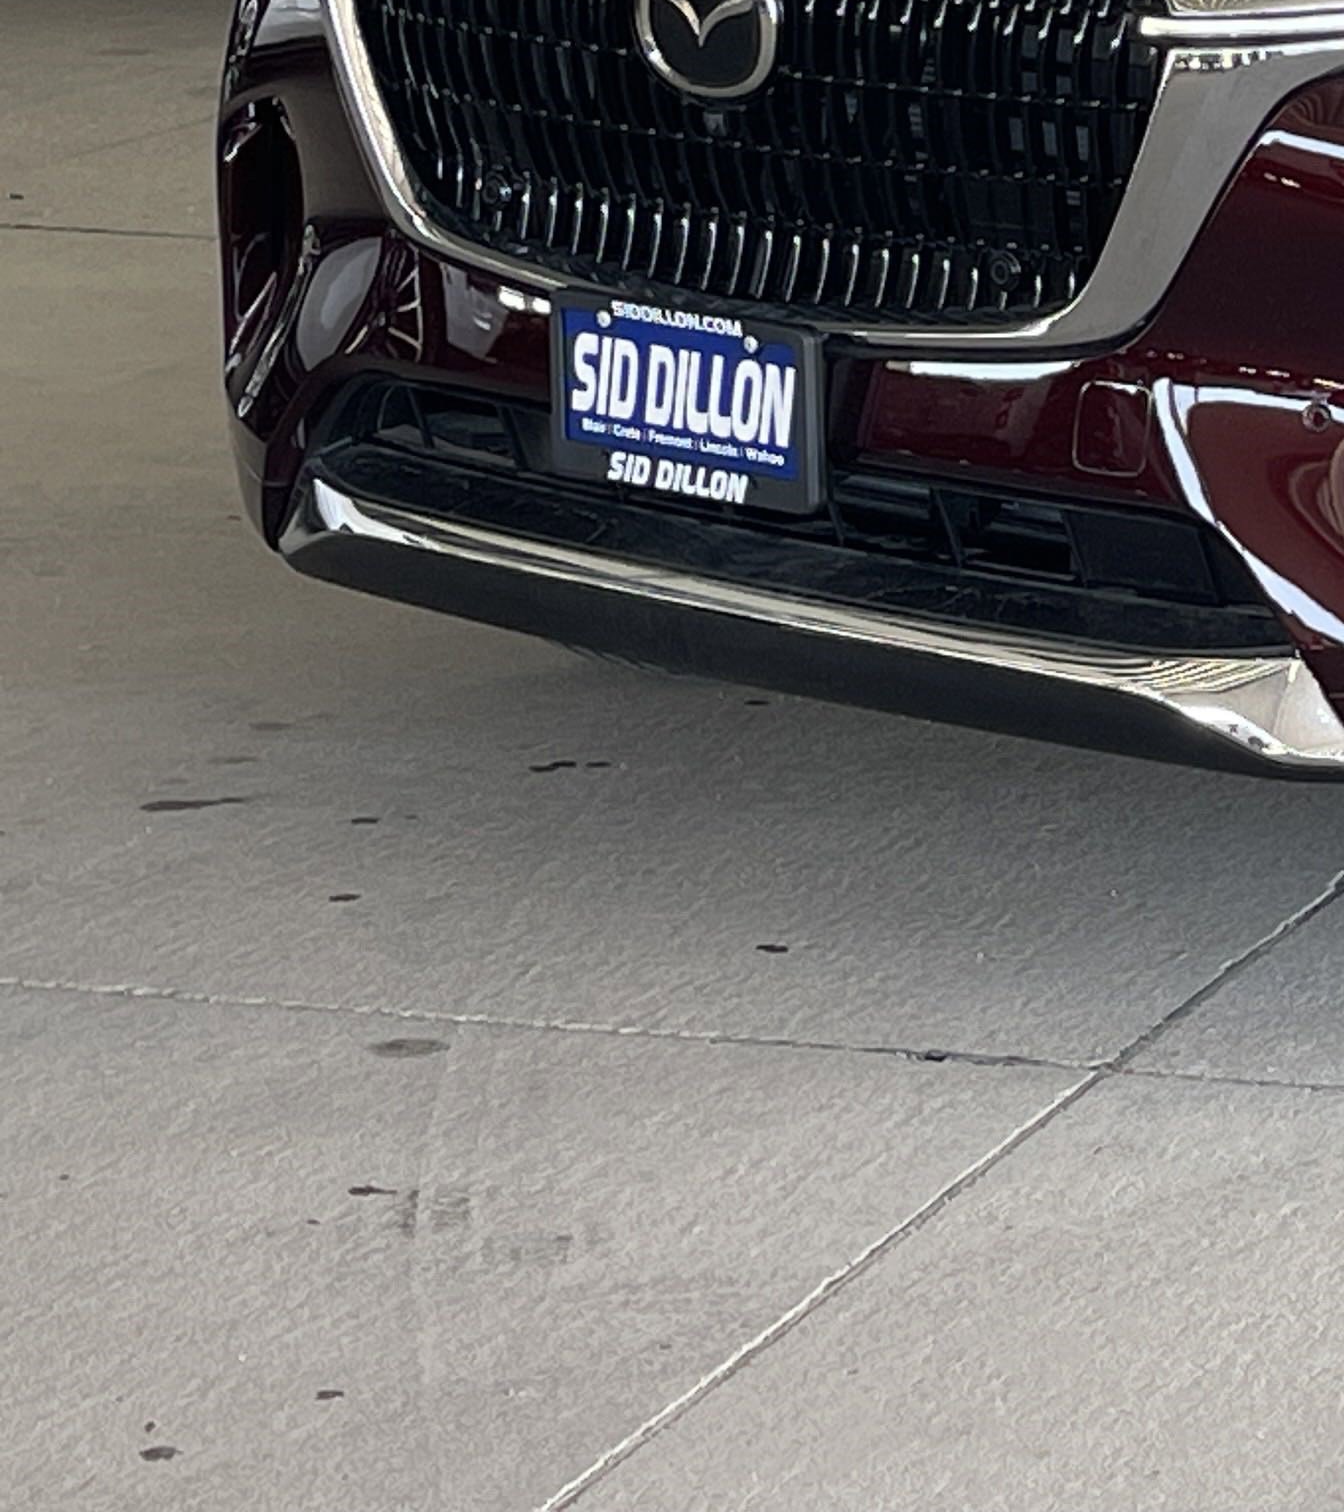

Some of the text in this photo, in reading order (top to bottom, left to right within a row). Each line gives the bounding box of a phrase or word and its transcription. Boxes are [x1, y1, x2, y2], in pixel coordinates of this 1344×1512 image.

[571, 332, 796, 448] SID DILLON
[607, 451, 748, 504] SID DILLON
